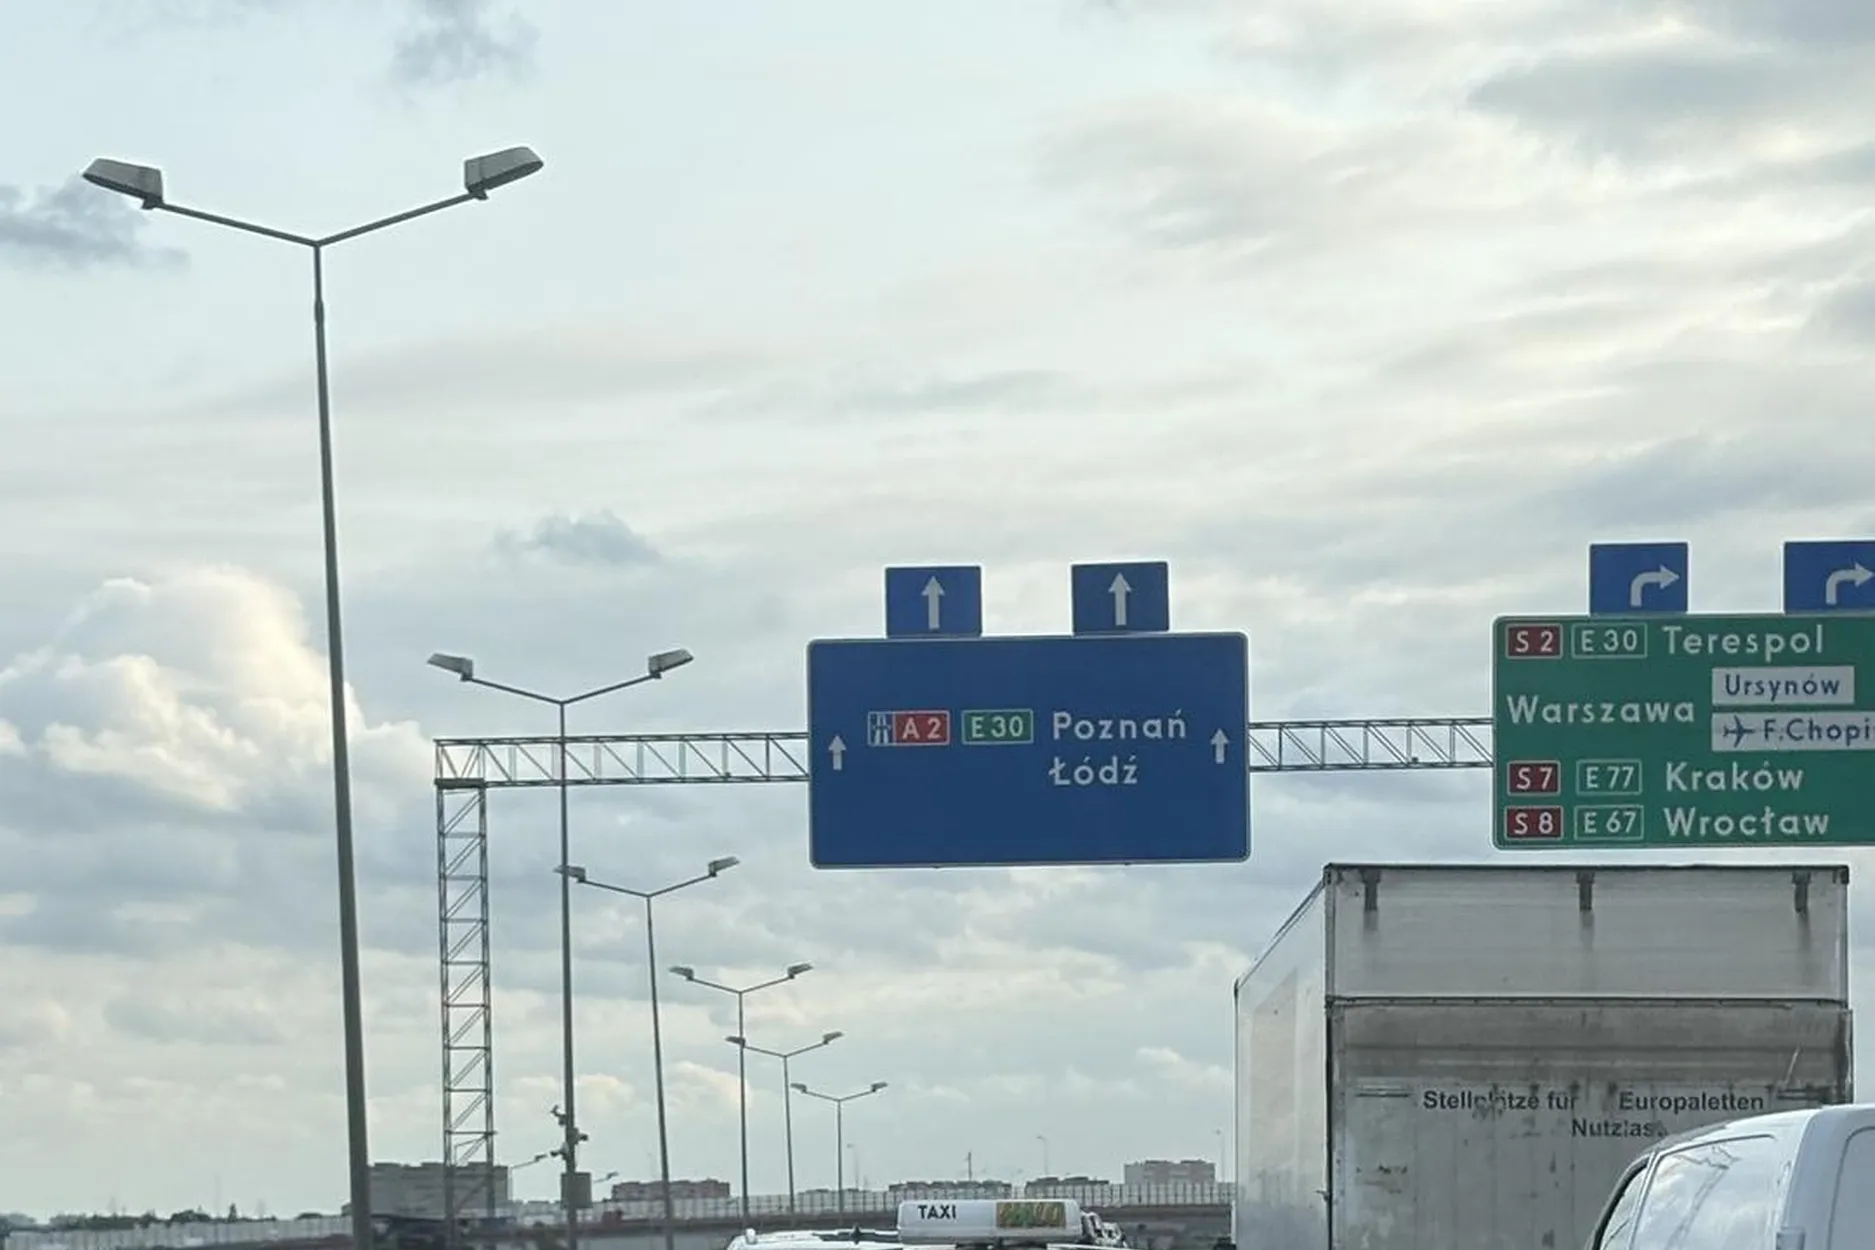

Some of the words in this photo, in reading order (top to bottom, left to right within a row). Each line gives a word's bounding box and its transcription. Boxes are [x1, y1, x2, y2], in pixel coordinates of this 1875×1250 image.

[1662, 624, 1824, 662] Terespol
[1725, 674, 1840, 701] Ursynów
[1053, 708, 1187, 740] Poznań
[1507, 696, 1695, 723] Warszawa
[1764, 716, 1875, 747] F.Chopi
[1048, 756, 1139, 786] Łódź
[1665, 760, 1803, 791] Kraków
[1663, 806, 1829, 837] Wrocław
[1547, 1090, 1576, 1111] für
[1619, 1090, 1764, 1115] Europaletten
[918, 1205, 956, 1220] TAXI
